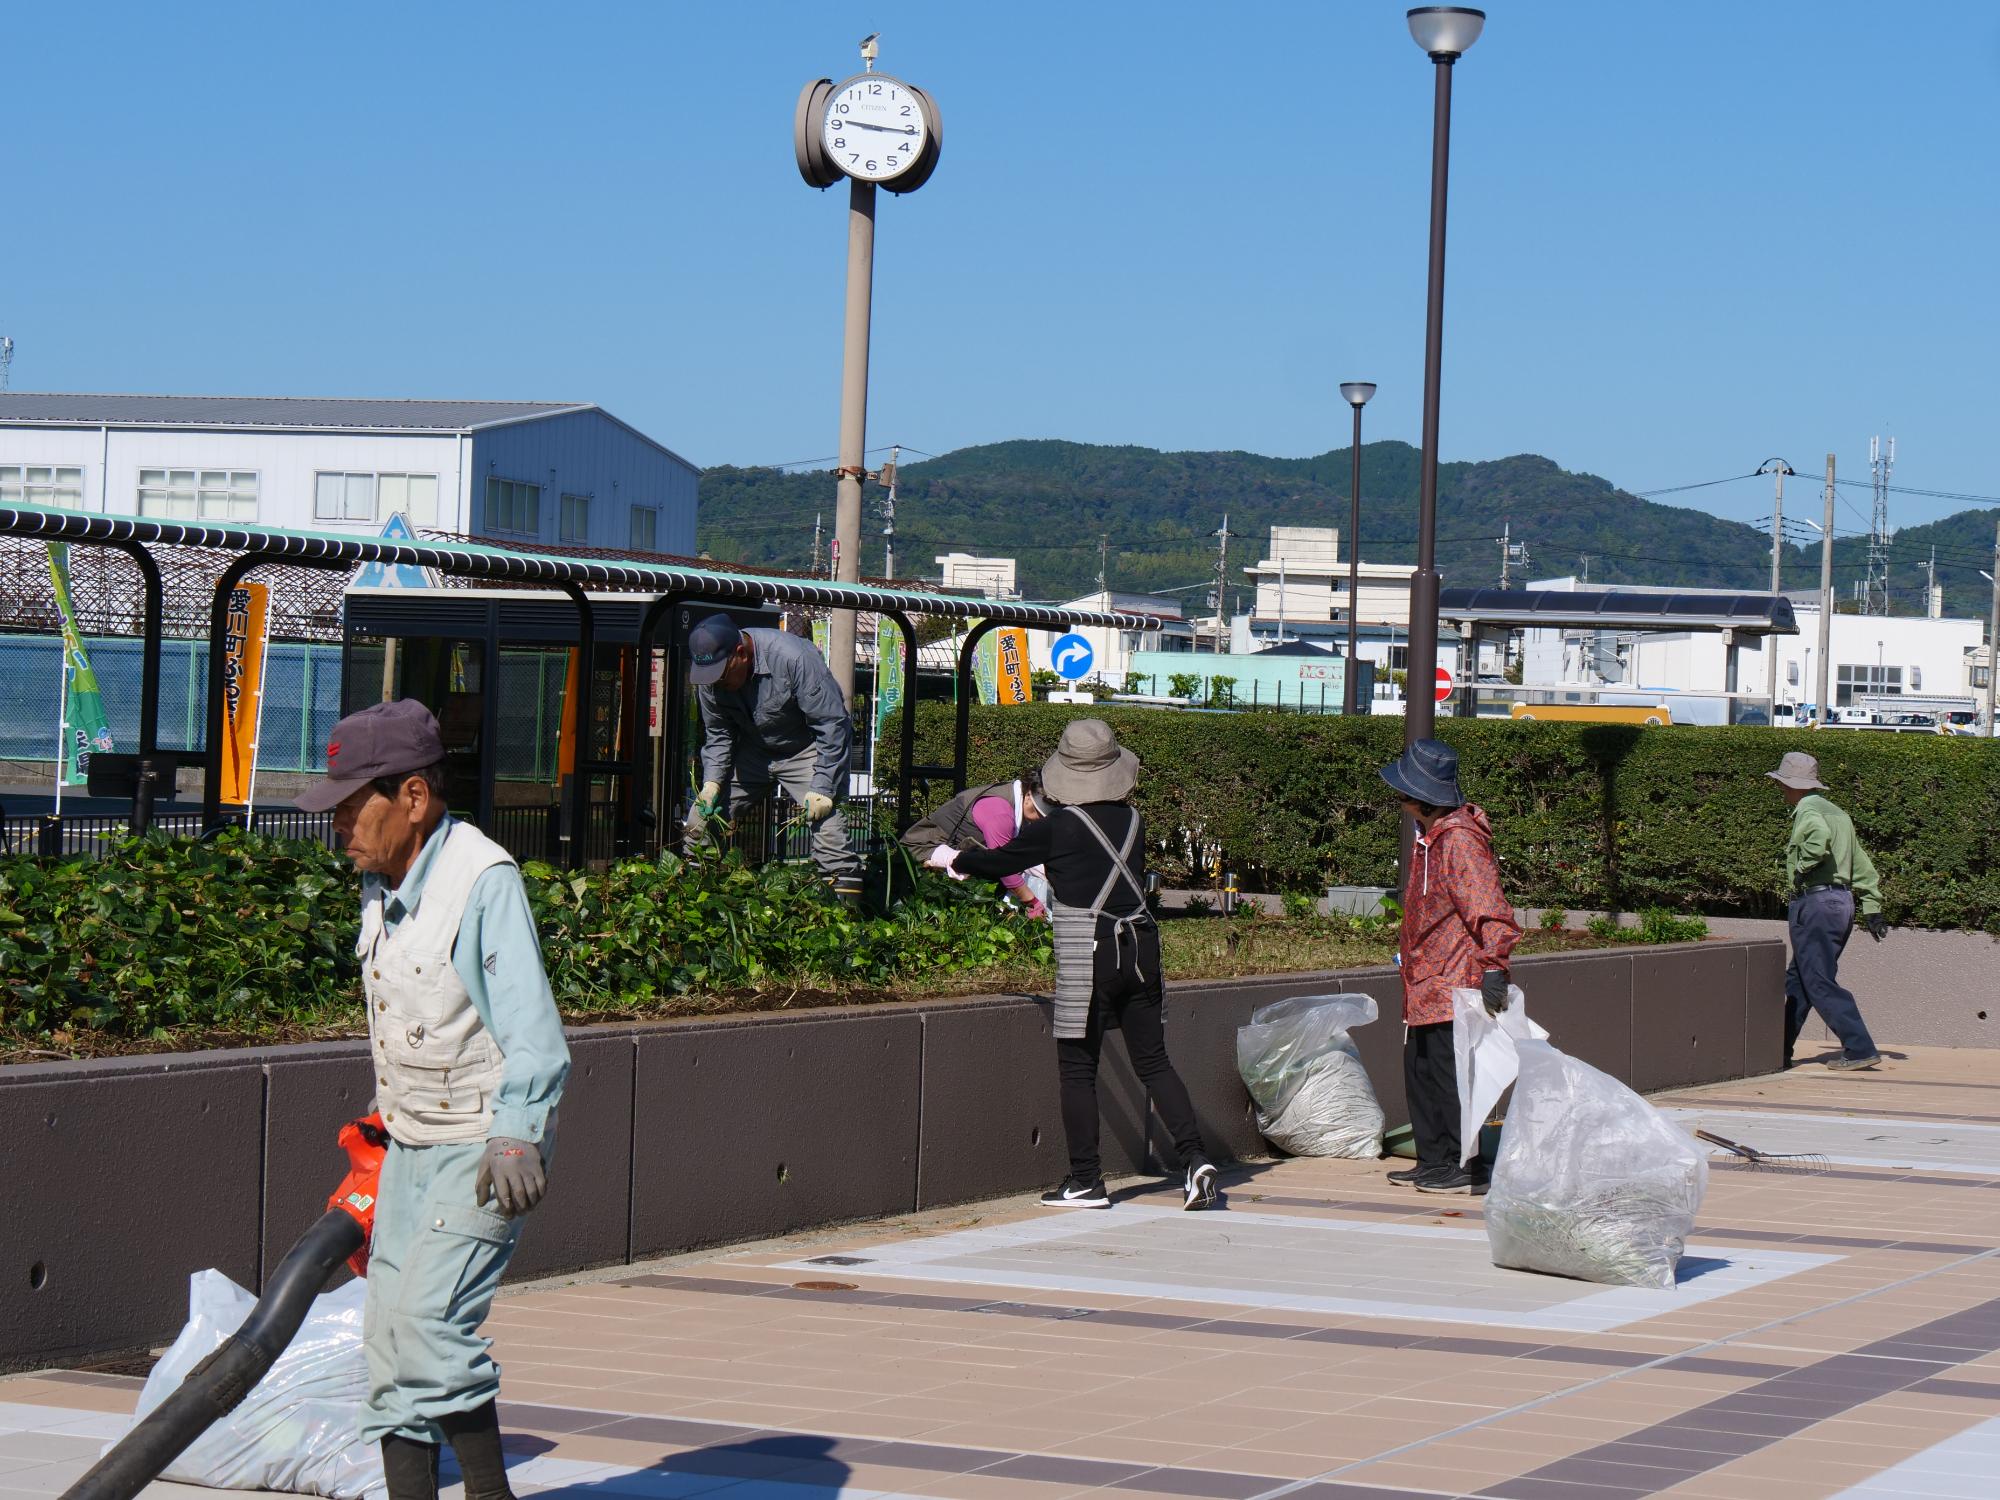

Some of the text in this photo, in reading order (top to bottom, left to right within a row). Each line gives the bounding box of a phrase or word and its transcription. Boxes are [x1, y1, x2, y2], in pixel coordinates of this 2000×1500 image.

[849, 90, 862, 100] 11
[868, 84, 882, 95] 12
[891, 90, 895, 100] 1
[835, 103, 850, 114] 10
[900, 105, 911, 116] 2
[831, 119, 843, 130] 9
[904, 125, 916, 136] 3
[834, 137, 846, 148] 8
[897, 142, 910, 152] 4
[848, 153, 860, 164] 7
[886, 155, 898, 167] 5
[865, 160, 877, 171] 6
[1000, 634, 1026, 702] 愛川町ふる
